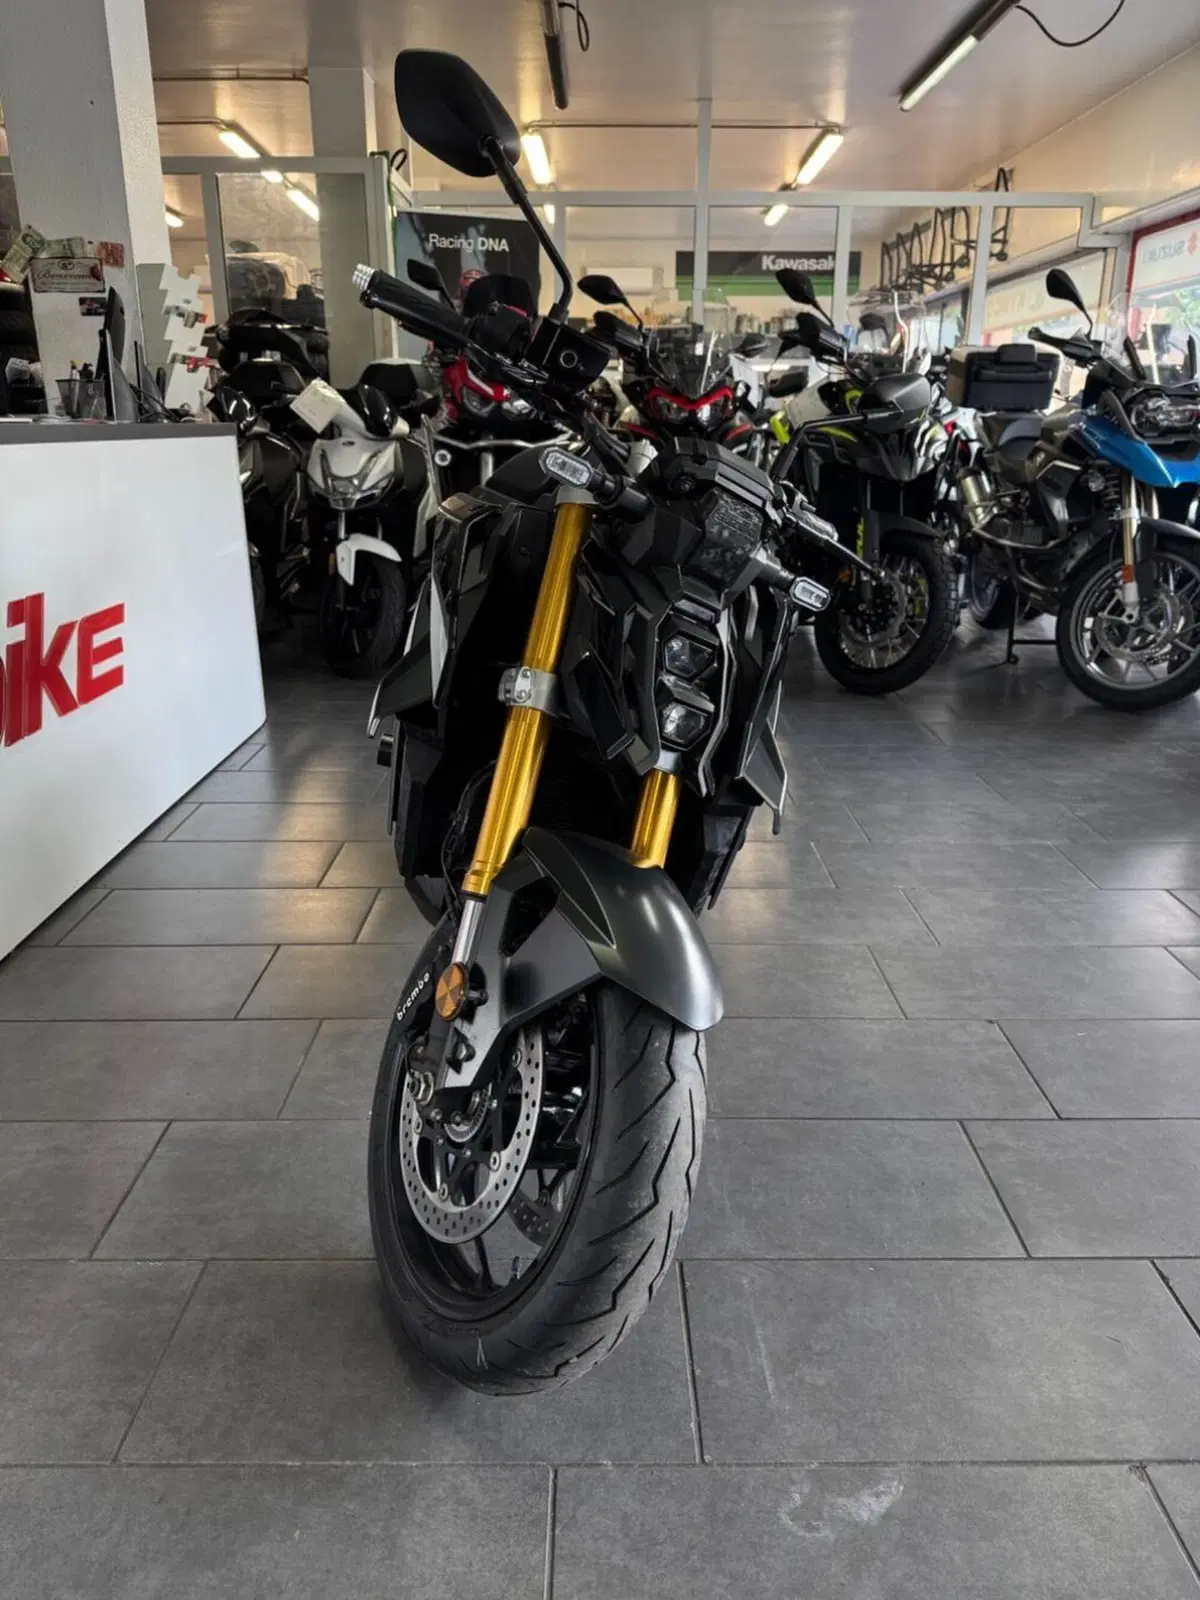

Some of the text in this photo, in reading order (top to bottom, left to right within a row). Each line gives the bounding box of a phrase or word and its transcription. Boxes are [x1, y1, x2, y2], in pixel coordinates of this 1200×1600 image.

[428, 233, 509, 253] Racing DNA
[762, 254, 836, 271] Kawasak
[397, 972, 430, 1020] brembo
